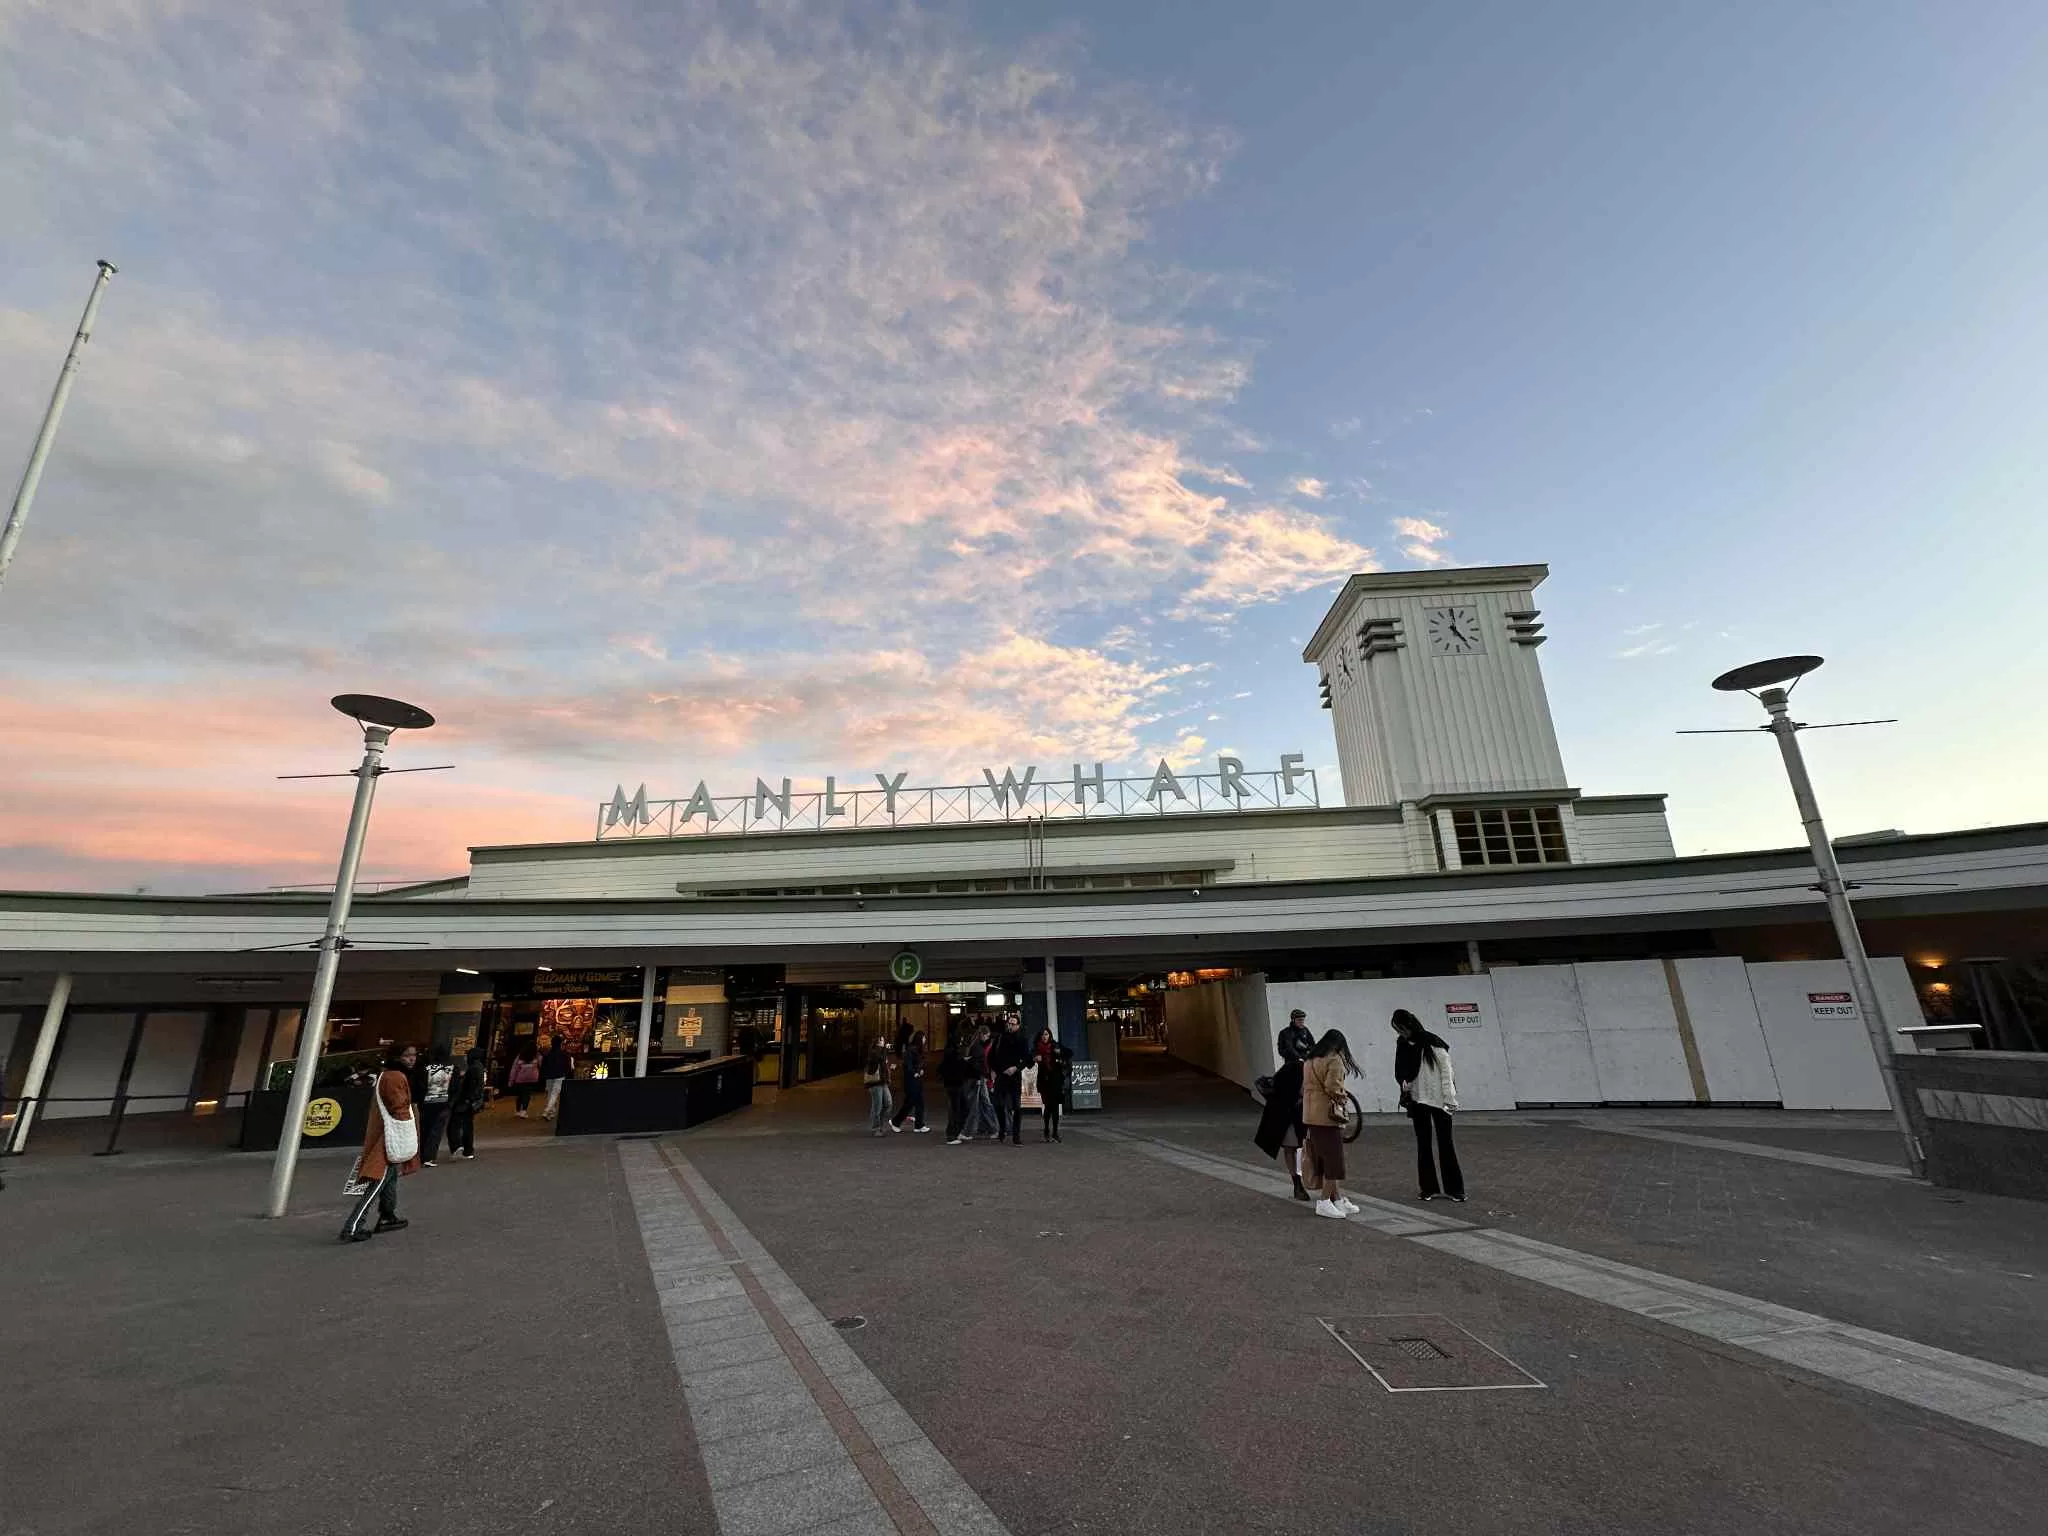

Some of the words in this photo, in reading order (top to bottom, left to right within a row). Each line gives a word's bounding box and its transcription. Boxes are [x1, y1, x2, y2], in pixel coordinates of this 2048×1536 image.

[606, 772, 908, 826] MANLY
[983, 752, 1305, 810] WHARF
[902, 959, 911, 976] F
[1814, 1007, 1835, 1015] KEEP
[1836, 1006, 1853, 1015] OUT
[1449, 1016, 1465, 1024] KEEP
[1466, 1015, 1479, 1024] OUT
